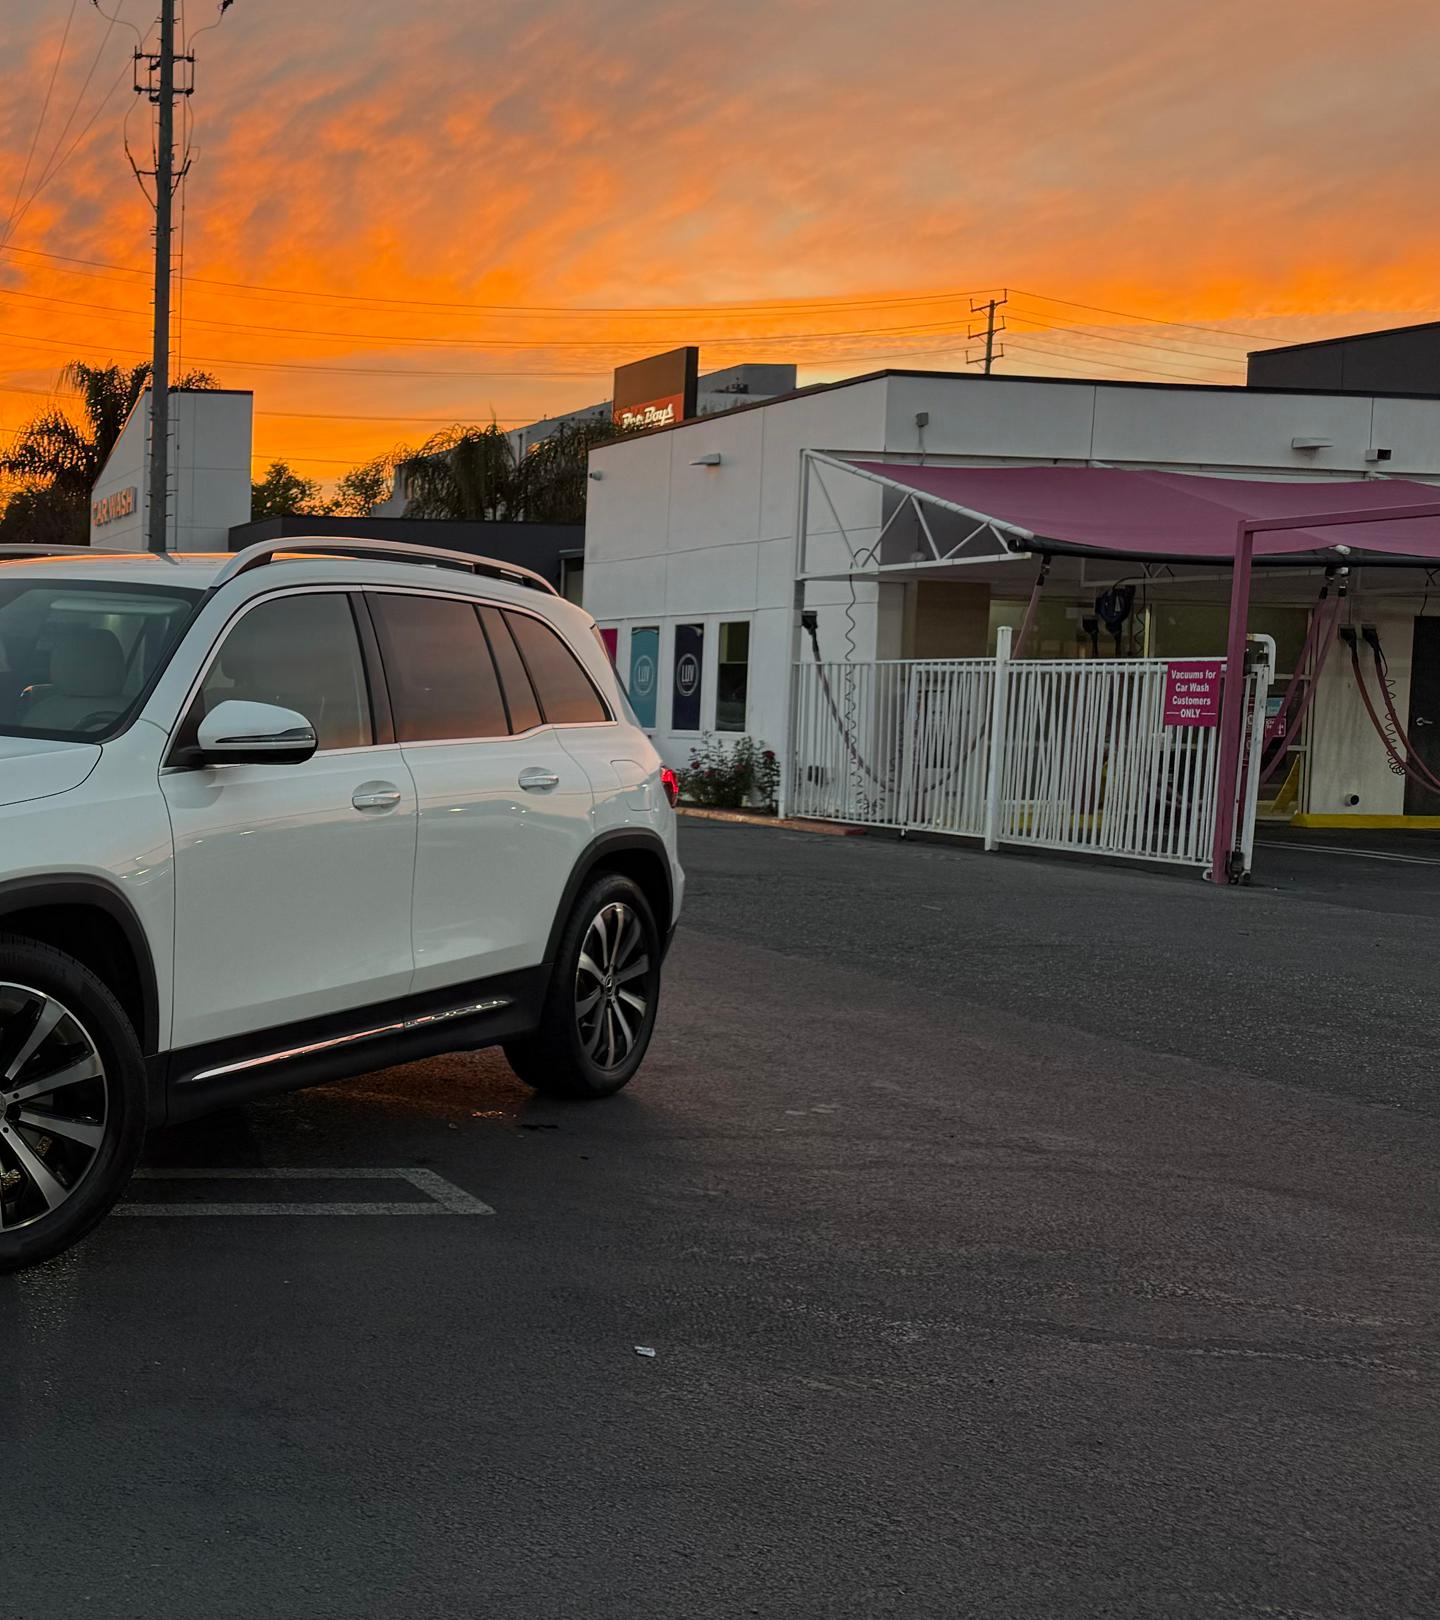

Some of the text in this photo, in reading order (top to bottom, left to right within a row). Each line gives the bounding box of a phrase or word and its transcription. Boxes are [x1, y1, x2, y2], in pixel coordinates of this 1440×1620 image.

[644, 403, 674, 426] Boys
[93, 488, 134, 527] CAR WASH
[681, 664, 694, 683] LUV
[1171, 669, 1217, 680] Vacuums for
[1175, 682, 1210, 693] Car Wash
[1172, 695, 1211, 706] Customers
[1180, 708, 1201, 718] ONLY
